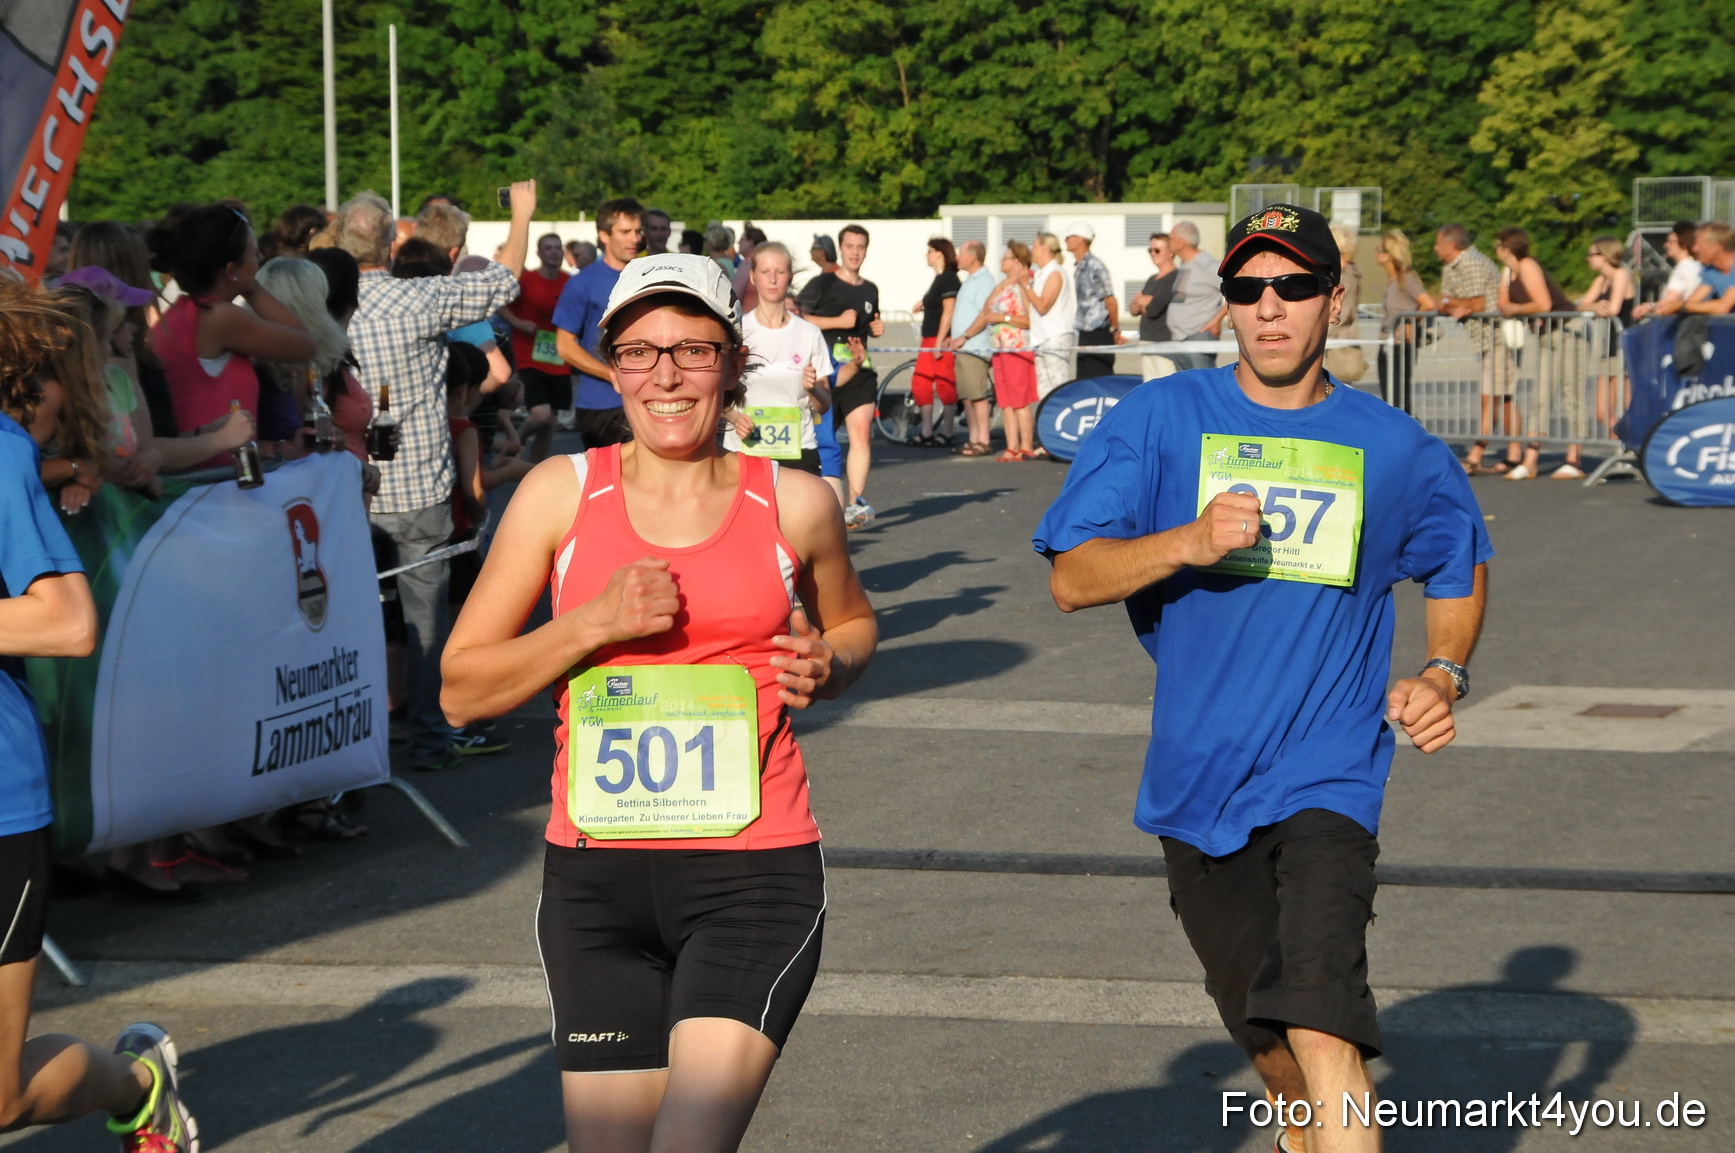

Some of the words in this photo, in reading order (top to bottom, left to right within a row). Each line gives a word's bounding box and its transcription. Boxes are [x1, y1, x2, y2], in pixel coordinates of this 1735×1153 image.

[655, 265, 685, 273] asics
[749, 424, 791, 445] 434
[1226, 455, 1284, 469] firmenlauf
[1226, 483, 1336, 544] 57
[1252, 544, 1281, 555] Gregor
[1283, 546, 1300, 556] Hiltl
[1224, 554, 1269, 565] Lebenshilfe
[1271, 558, 1308, 569] Neumarkt
[275, 646, 358, 706] Neumarkter
[596, 693, 658, 707] firmenlauf
[250, 690, 372, 777] Lammsbräu
[595, 725, 715, 794] 501
[616, 799, 650, 808] Bettina
[652, 798, 707, 807] Silberhorn
[578, 815, 635, 824] Kindergarten
[639, 814, 650, 822] Zu
[653, 813, 689, 821] Unserer
[692, 812, 723, 821] Lieben
[726, 812, 748, 820] Frau
[568, 1032, 616, 1042] CRAFT
